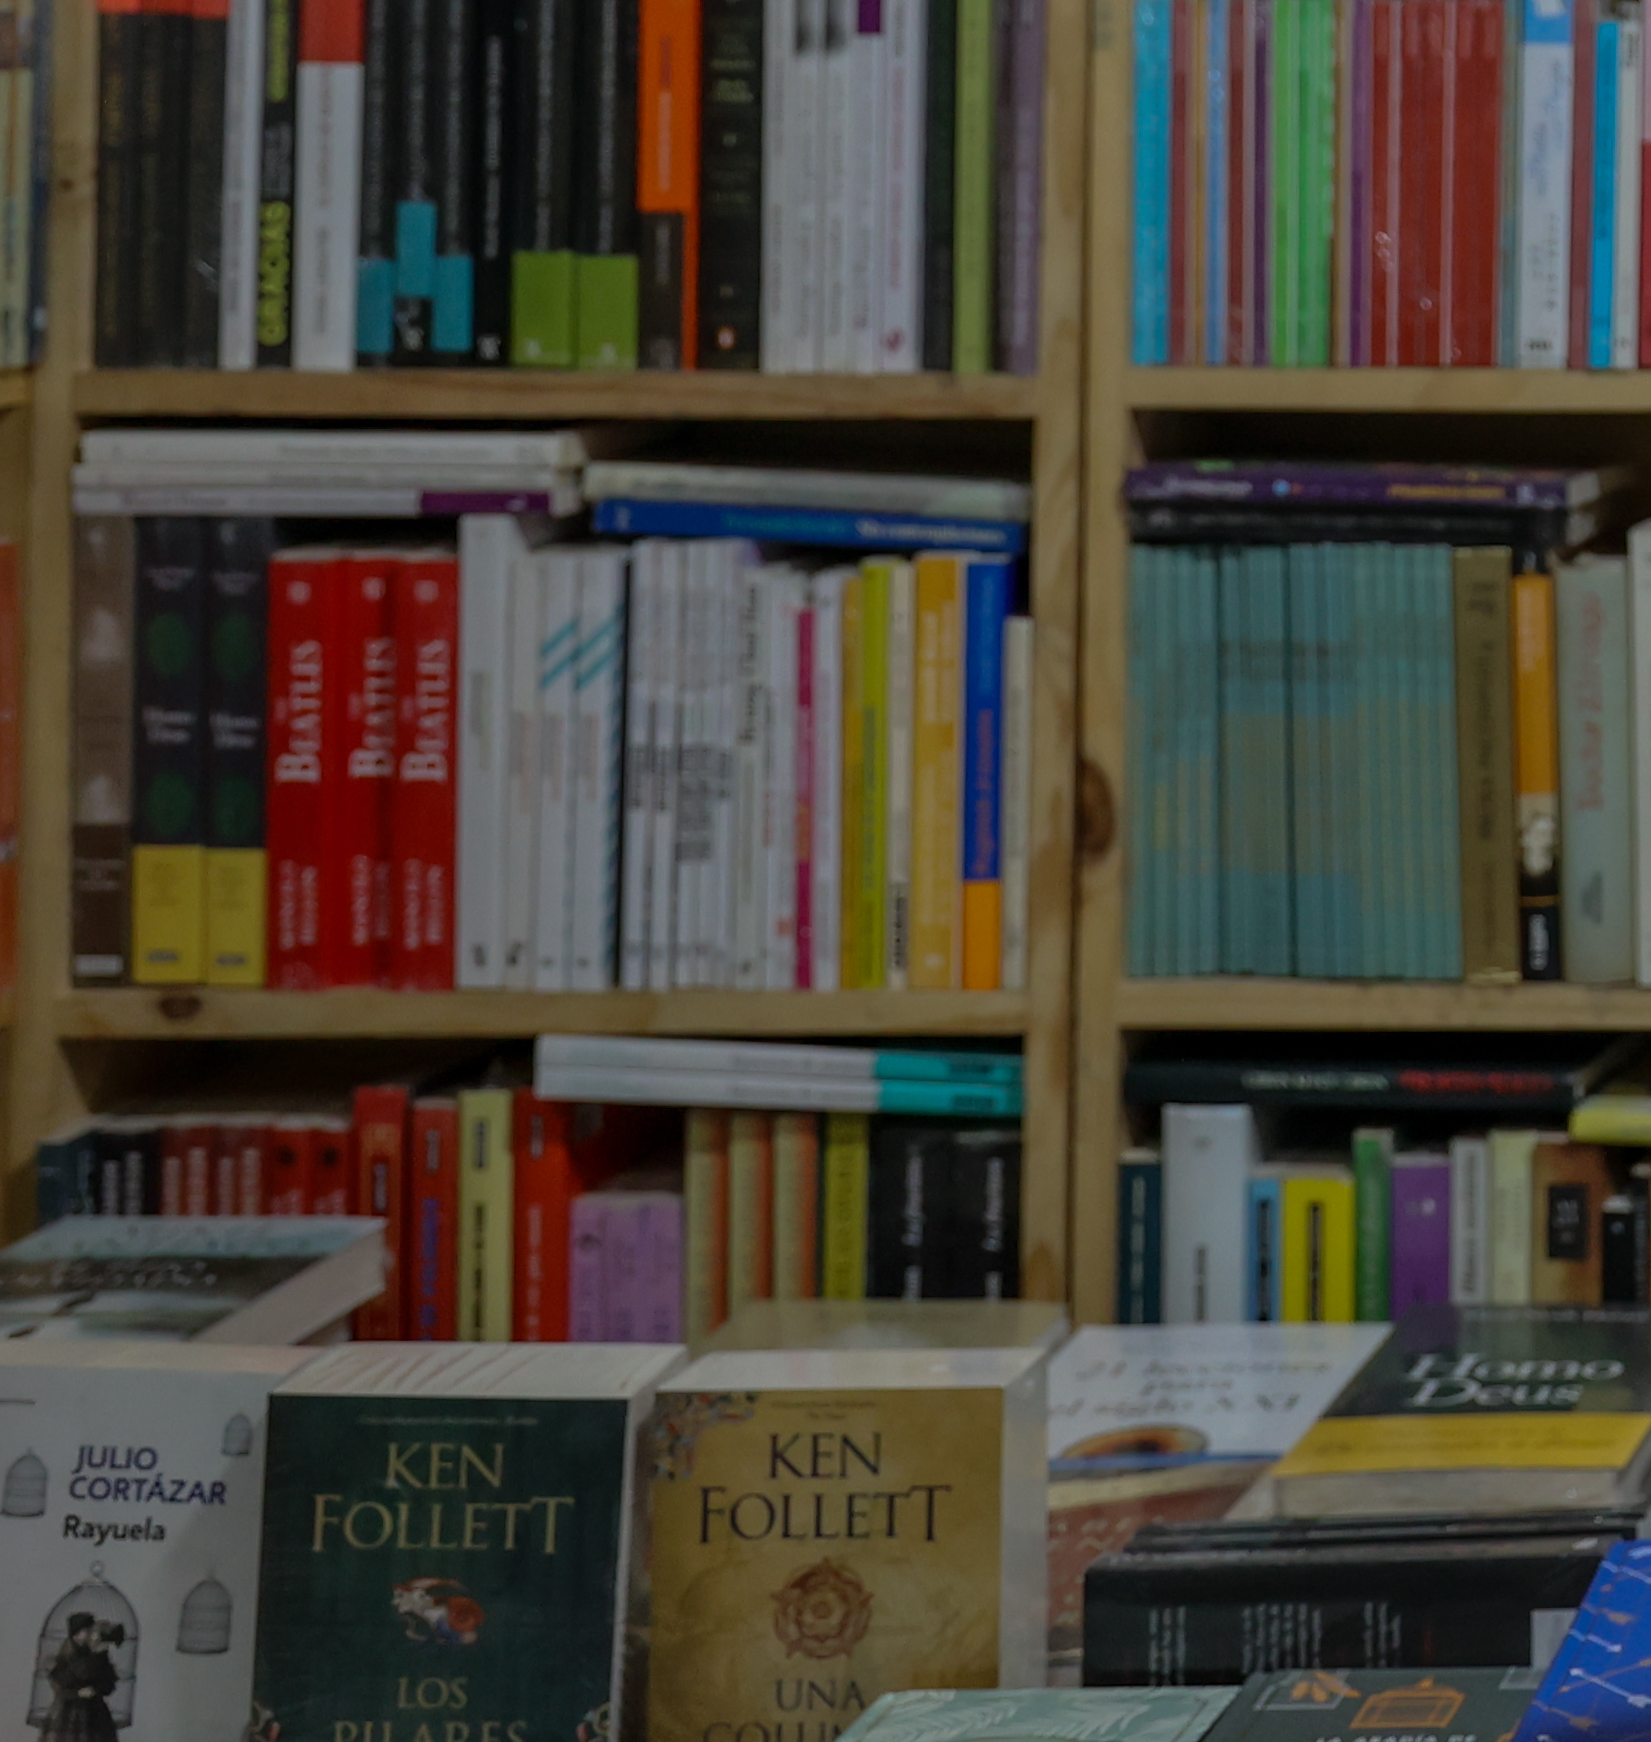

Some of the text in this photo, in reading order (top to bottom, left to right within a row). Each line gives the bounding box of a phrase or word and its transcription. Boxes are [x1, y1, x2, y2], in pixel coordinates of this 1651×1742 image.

[256, 201, 292, 346] GRACIAS
[274, 639, 323, 784] BEATLES
[347, 637, 397, 778] BEATLES
[398, 639, 449, 784] BEATLES
[1401, 1352, 1624, 1384] Homo
[1407, 1376, 1585, 1409] Deus
[72, 1444, 159, 1474] JULIO
[384, 1440, 506, 1492] KEN
[767, 1430, 882, 1480] KEN
[67, 1471, 227, 1506] CORTÁZAR
[697, 1482, 954, 1545] FOLLETT
[61, 1514, 167, 1547] Rayuela
[310, 1493, 576, 1556] FOLLETT
[397, 1675, 469, 1711] LOS
[774, 1677, 866, 1711] UNA
